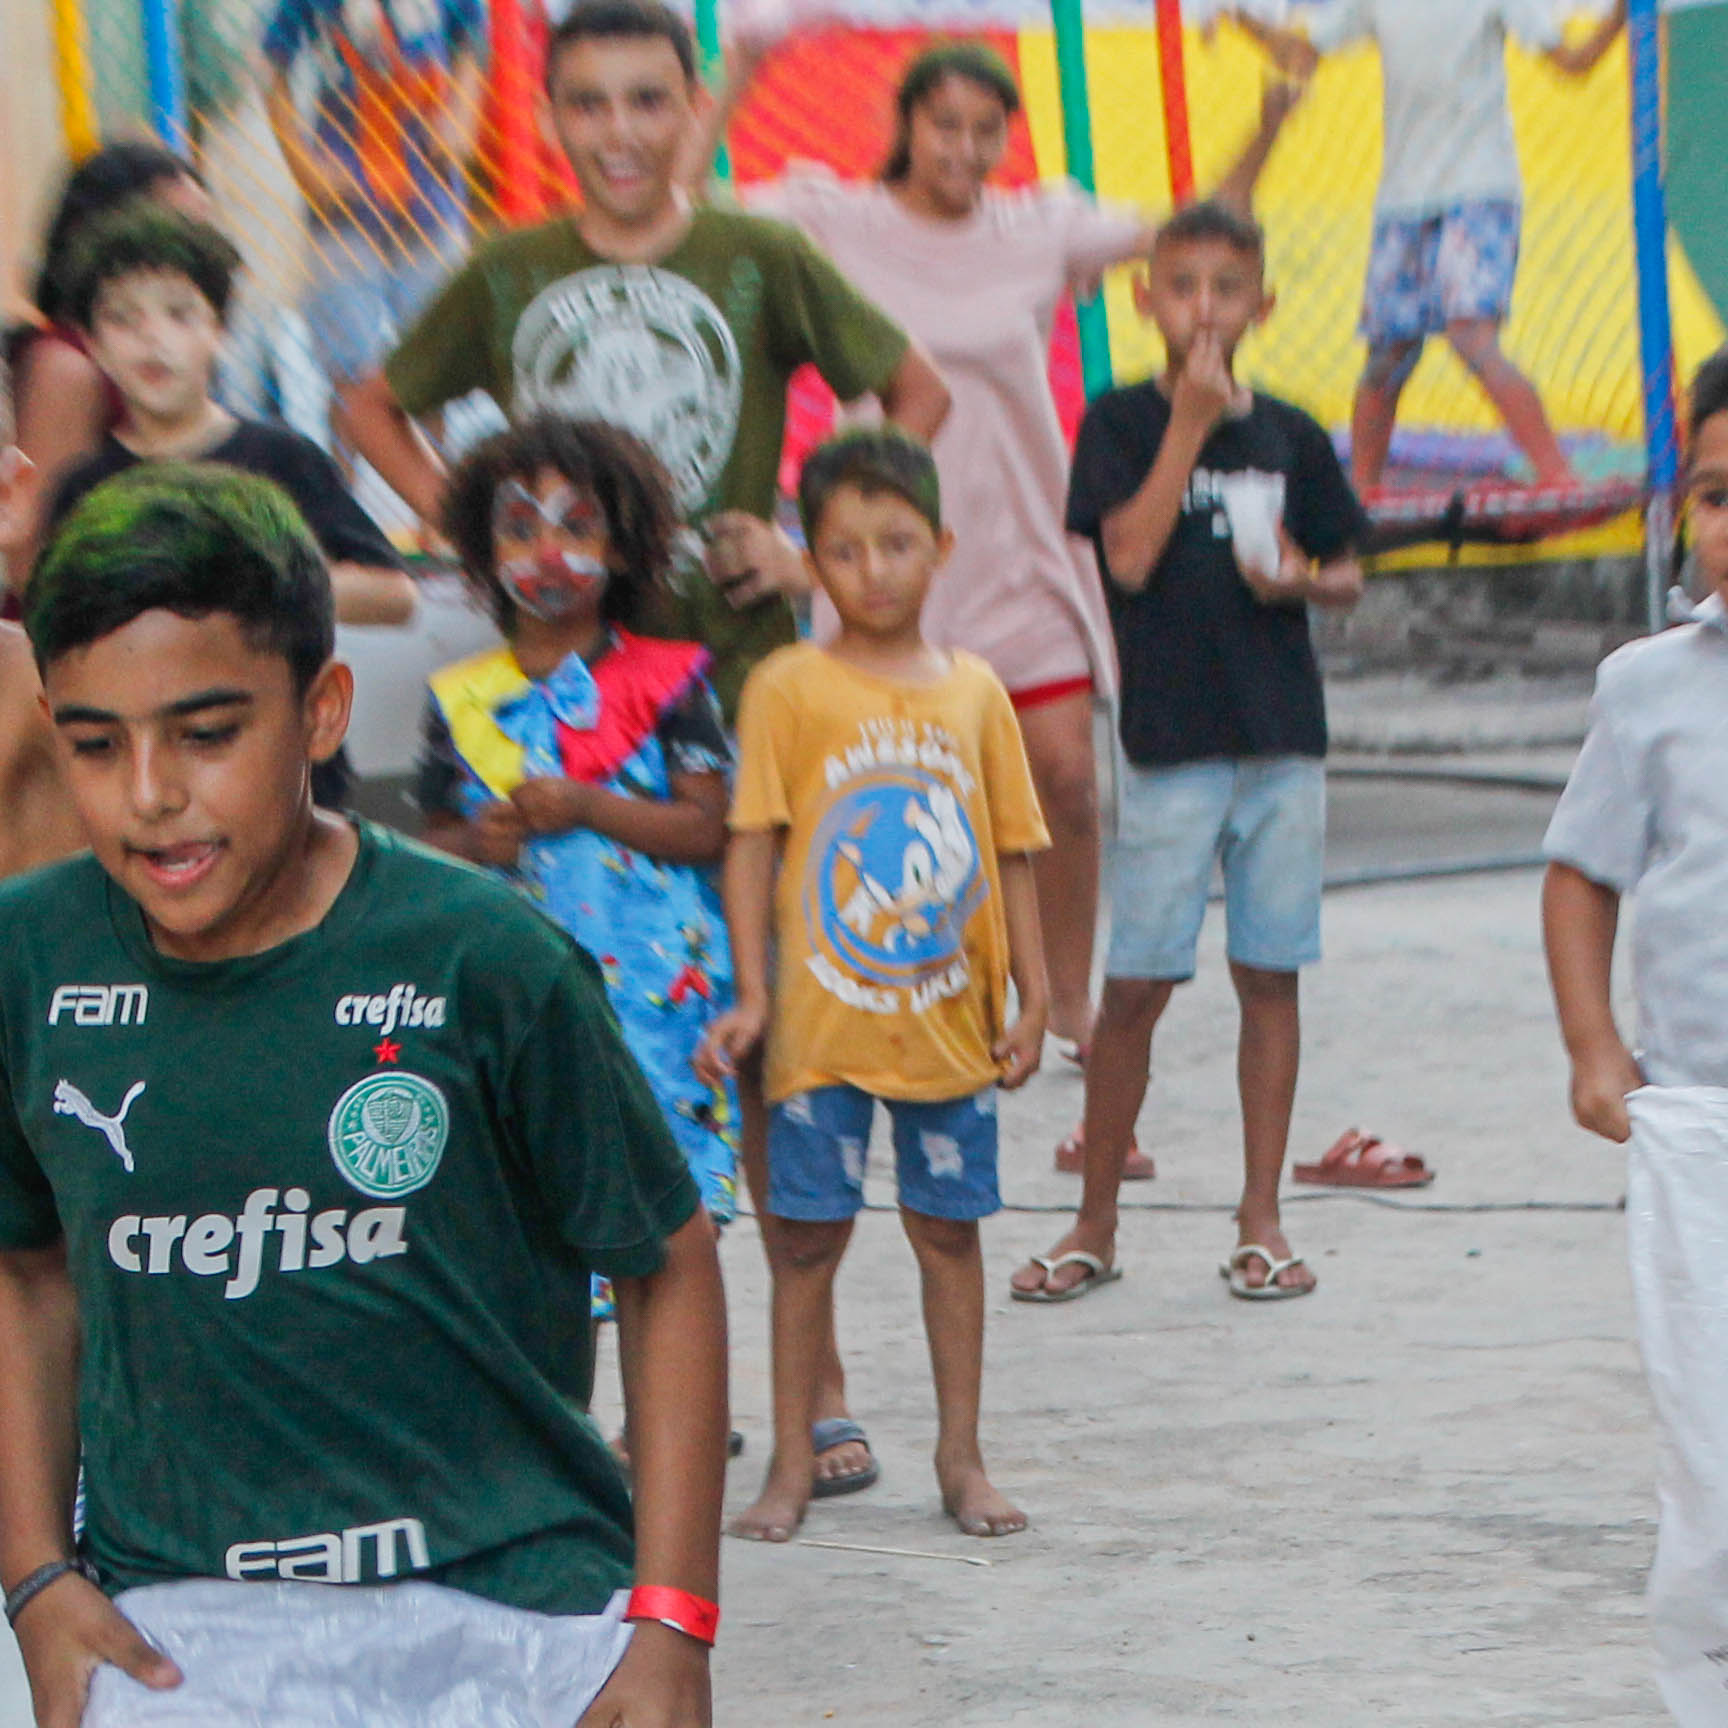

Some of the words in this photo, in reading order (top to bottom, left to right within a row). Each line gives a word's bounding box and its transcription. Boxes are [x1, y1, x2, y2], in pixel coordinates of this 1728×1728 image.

[335, 983, 447, 1036] crefisa
[342, 1126, 438, 1184] PALMEIRAS
[108, 1187, 408, 1299] crefisa
